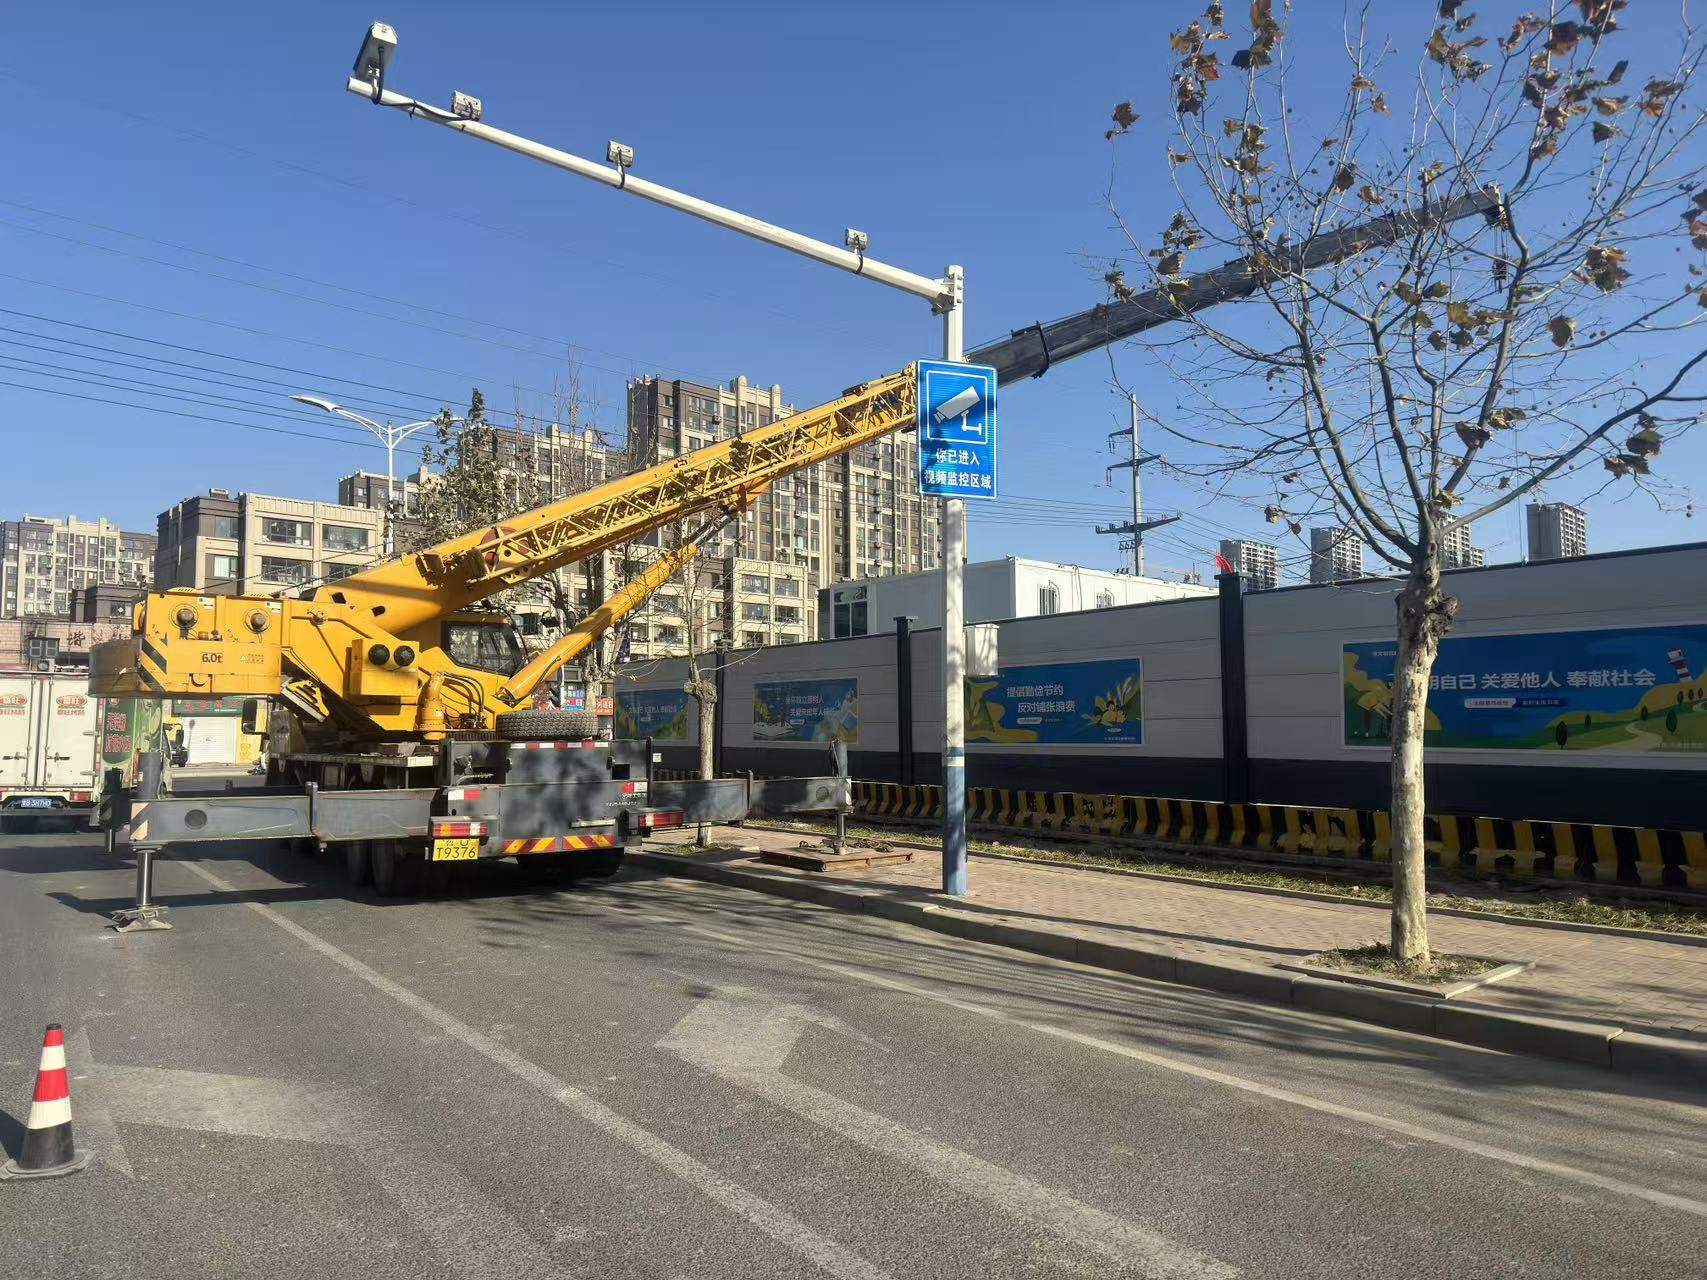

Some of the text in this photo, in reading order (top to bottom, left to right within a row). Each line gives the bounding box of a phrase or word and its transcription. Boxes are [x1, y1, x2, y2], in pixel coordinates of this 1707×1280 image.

[924, 469, 992, 489] 视频监控区域
[1480, 671, 1562, 690] 关爱他人
[1566, 668, 1656, 688] 奉献社会
[1017, 700, 1076, 714] 反对铺张浪费
[436, 846, 477, 859] T9376
